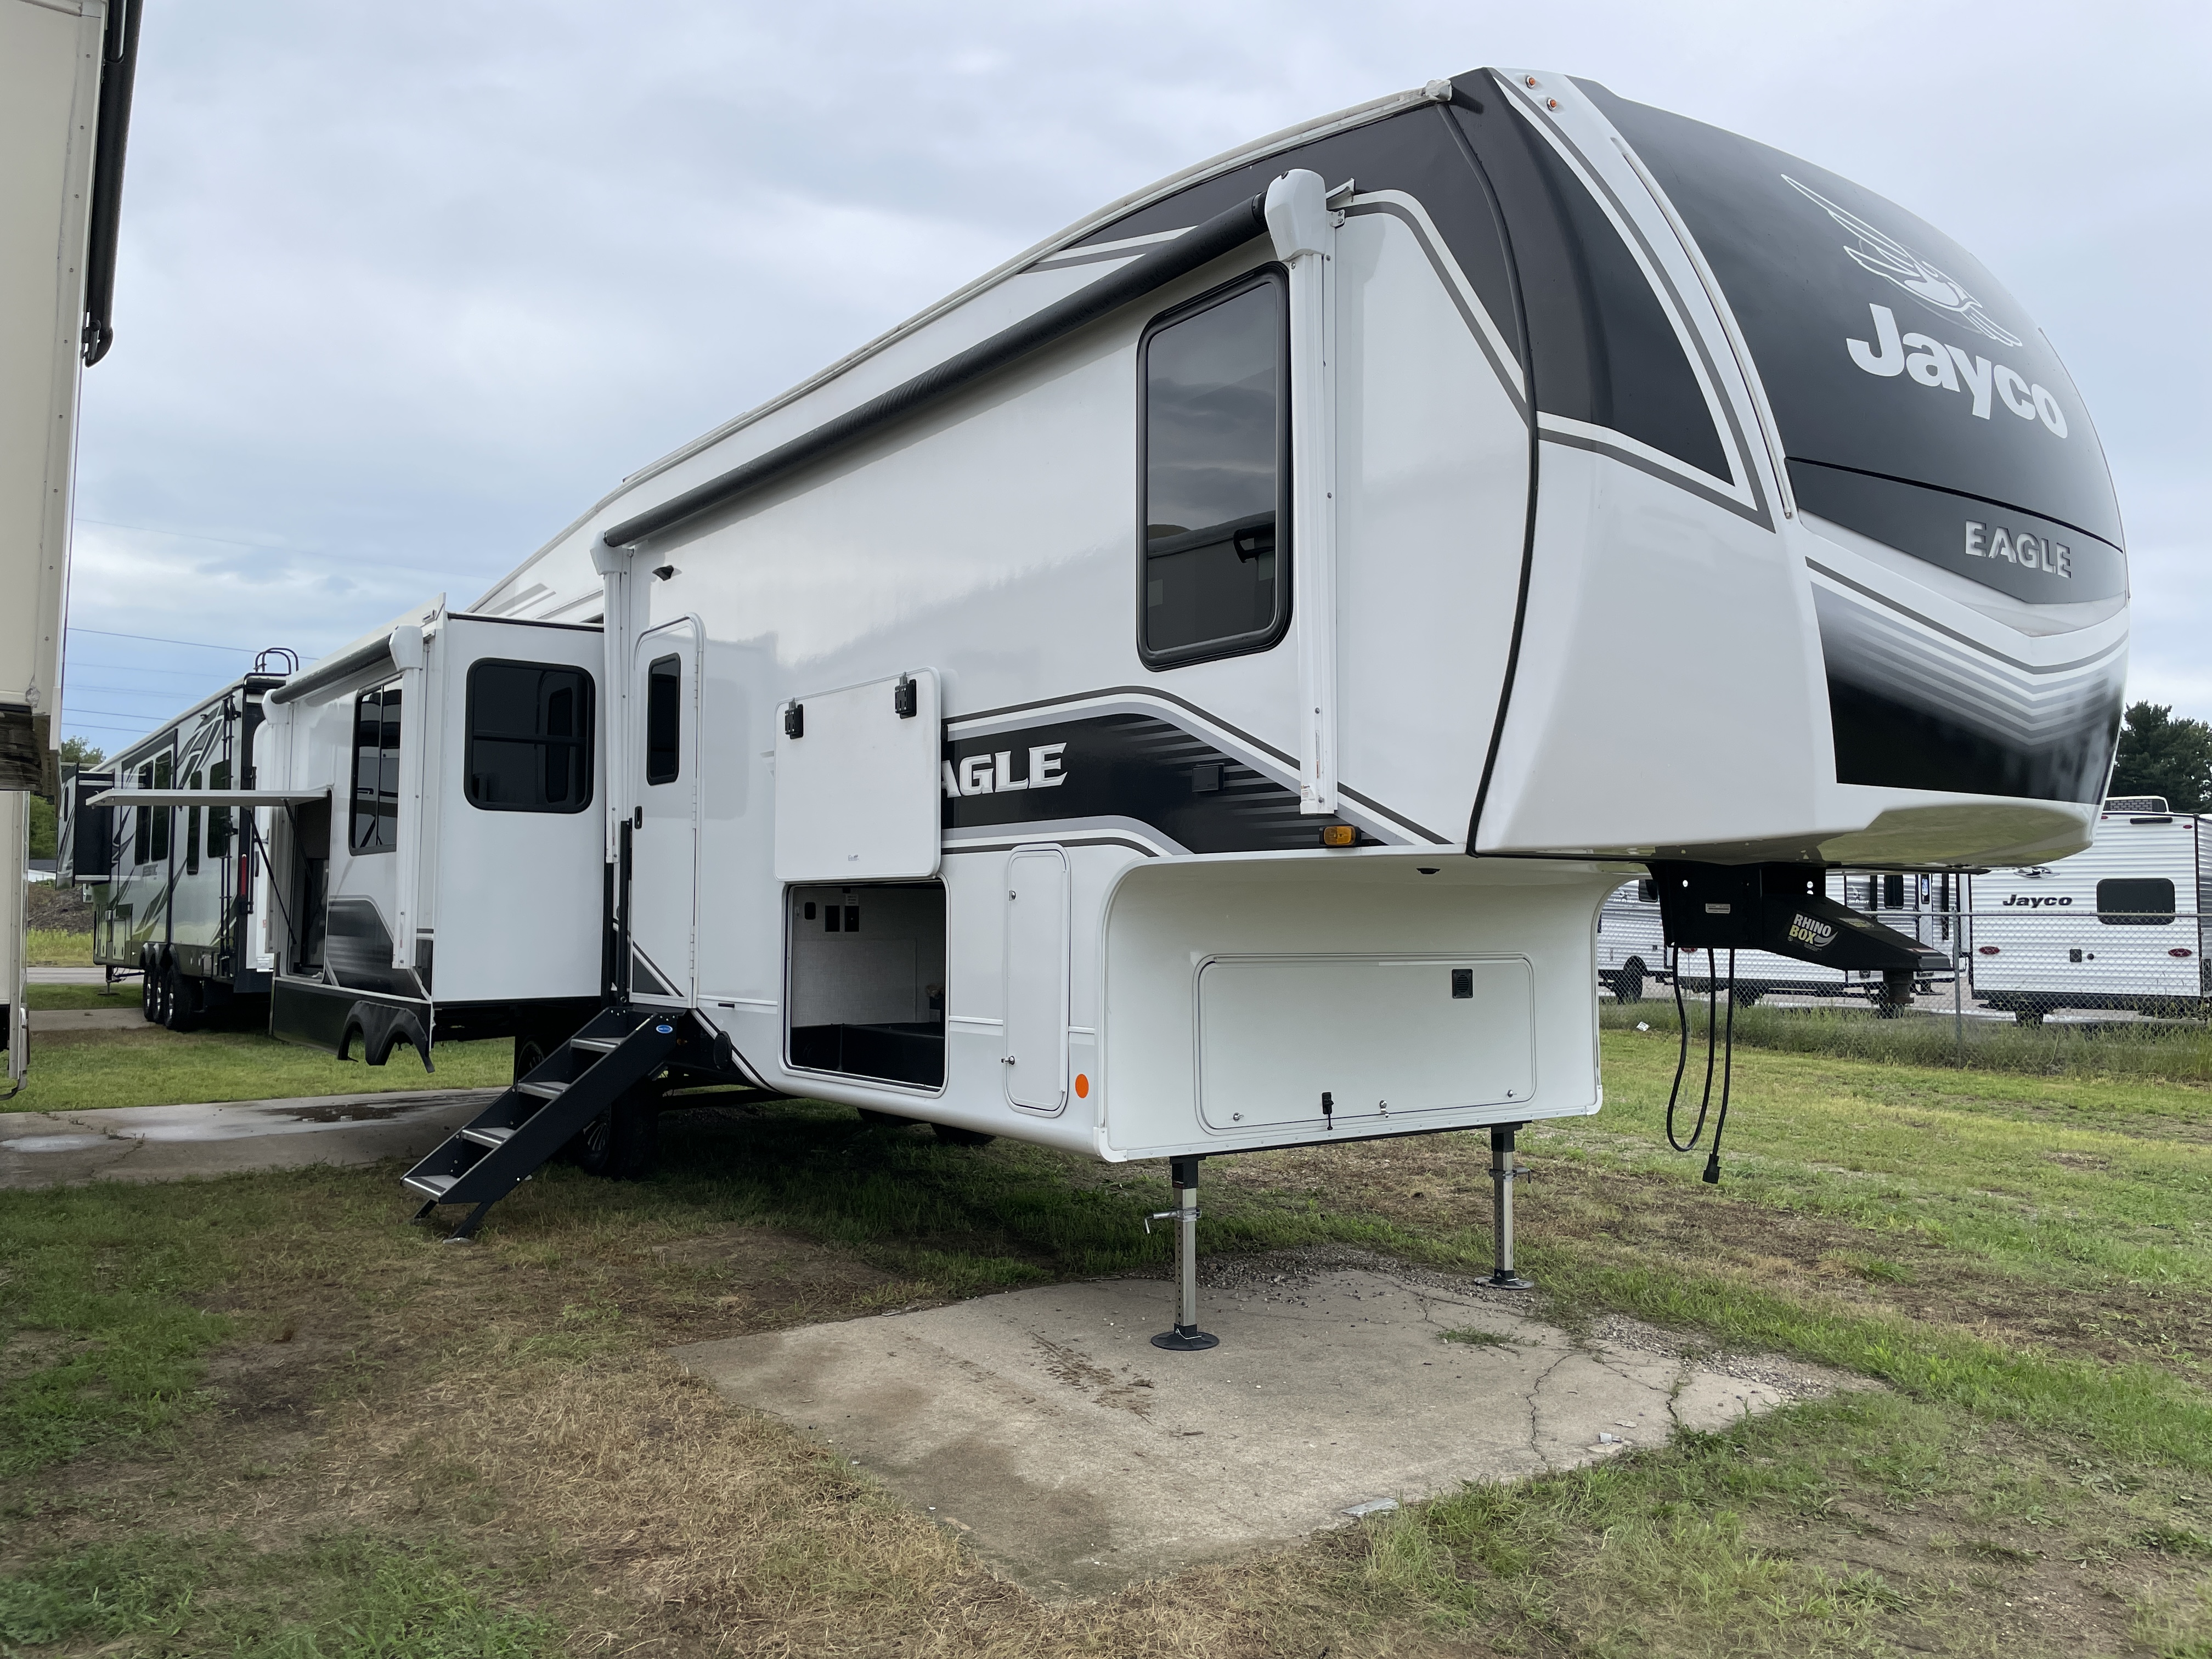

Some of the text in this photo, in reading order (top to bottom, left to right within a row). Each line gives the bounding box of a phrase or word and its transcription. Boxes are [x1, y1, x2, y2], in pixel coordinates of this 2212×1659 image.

[1846, 303, 2068, 439] Jayco
[1965, 520, 2072, 579] EAGLE
[2002, 894, 2073, 909] Jayco
[1789, 924, 1817, 944] BOX
[1793, 913, 1832, 937] RHINO
